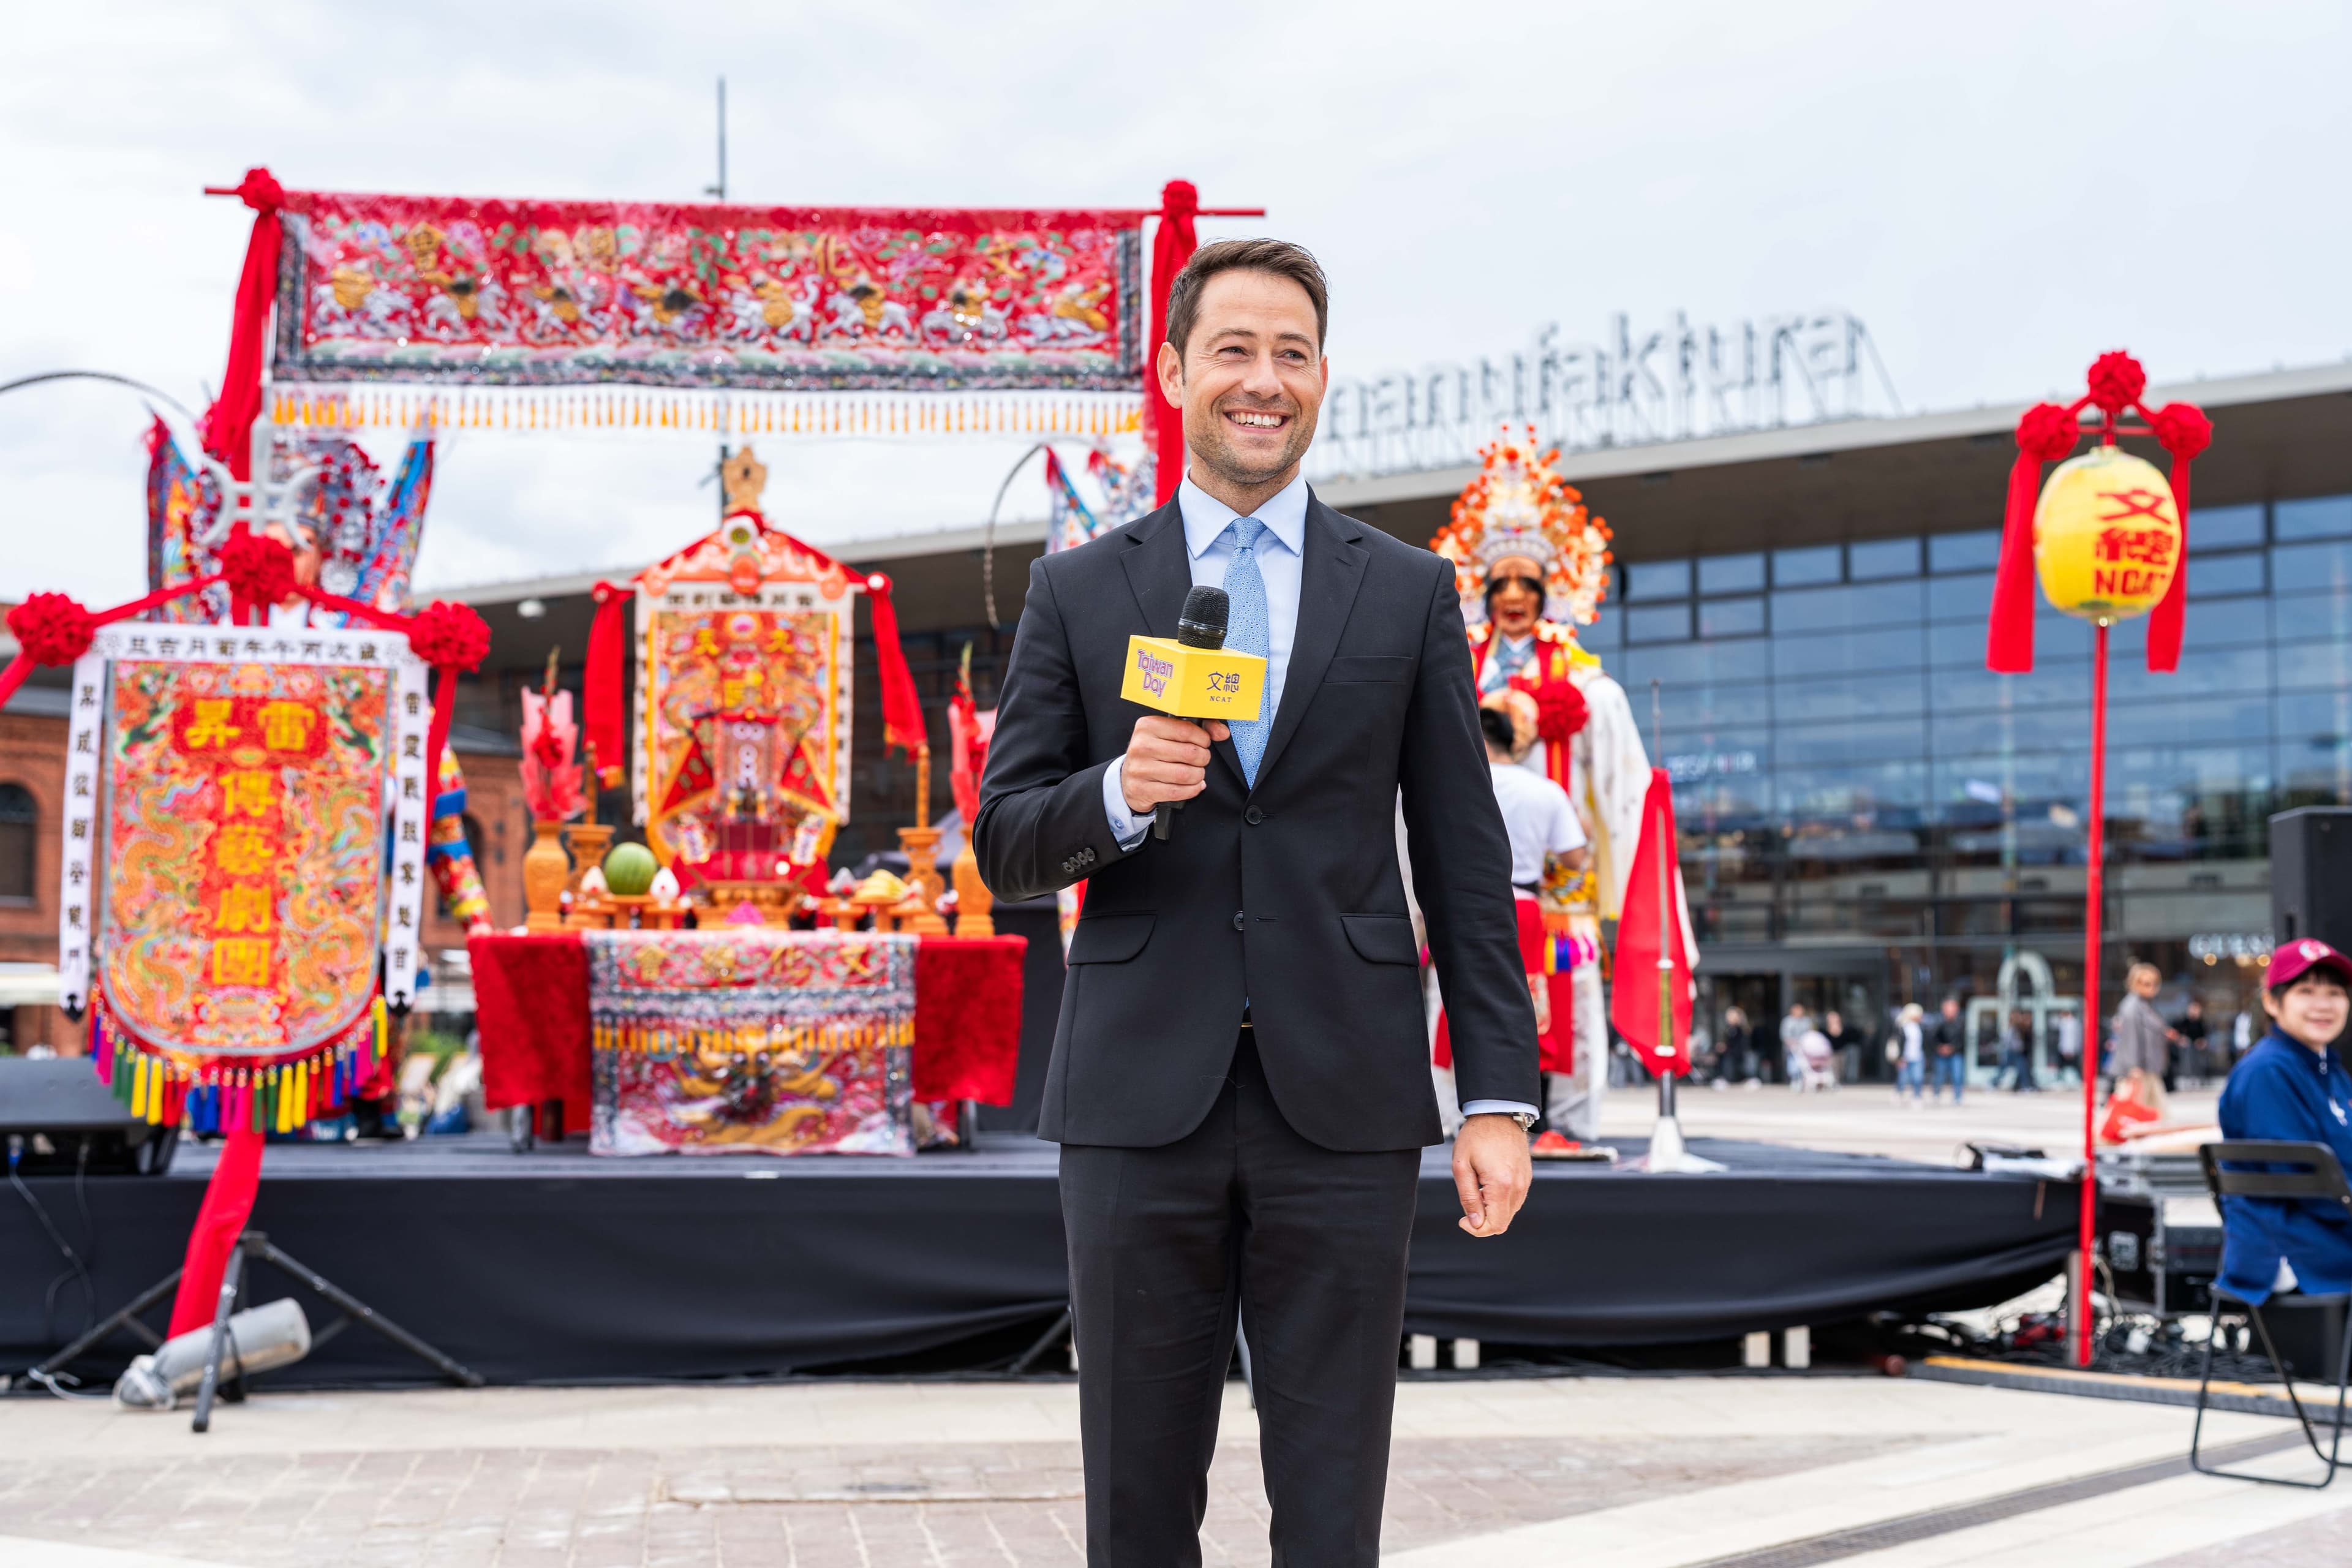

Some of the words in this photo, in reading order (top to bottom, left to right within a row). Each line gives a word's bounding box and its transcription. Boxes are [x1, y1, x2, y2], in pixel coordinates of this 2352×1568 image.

[1137, 650, 1174, 679] Taiwan
[1143, 671, 1166, 698] Day
[1206, 671, 1240, 693] 文總
